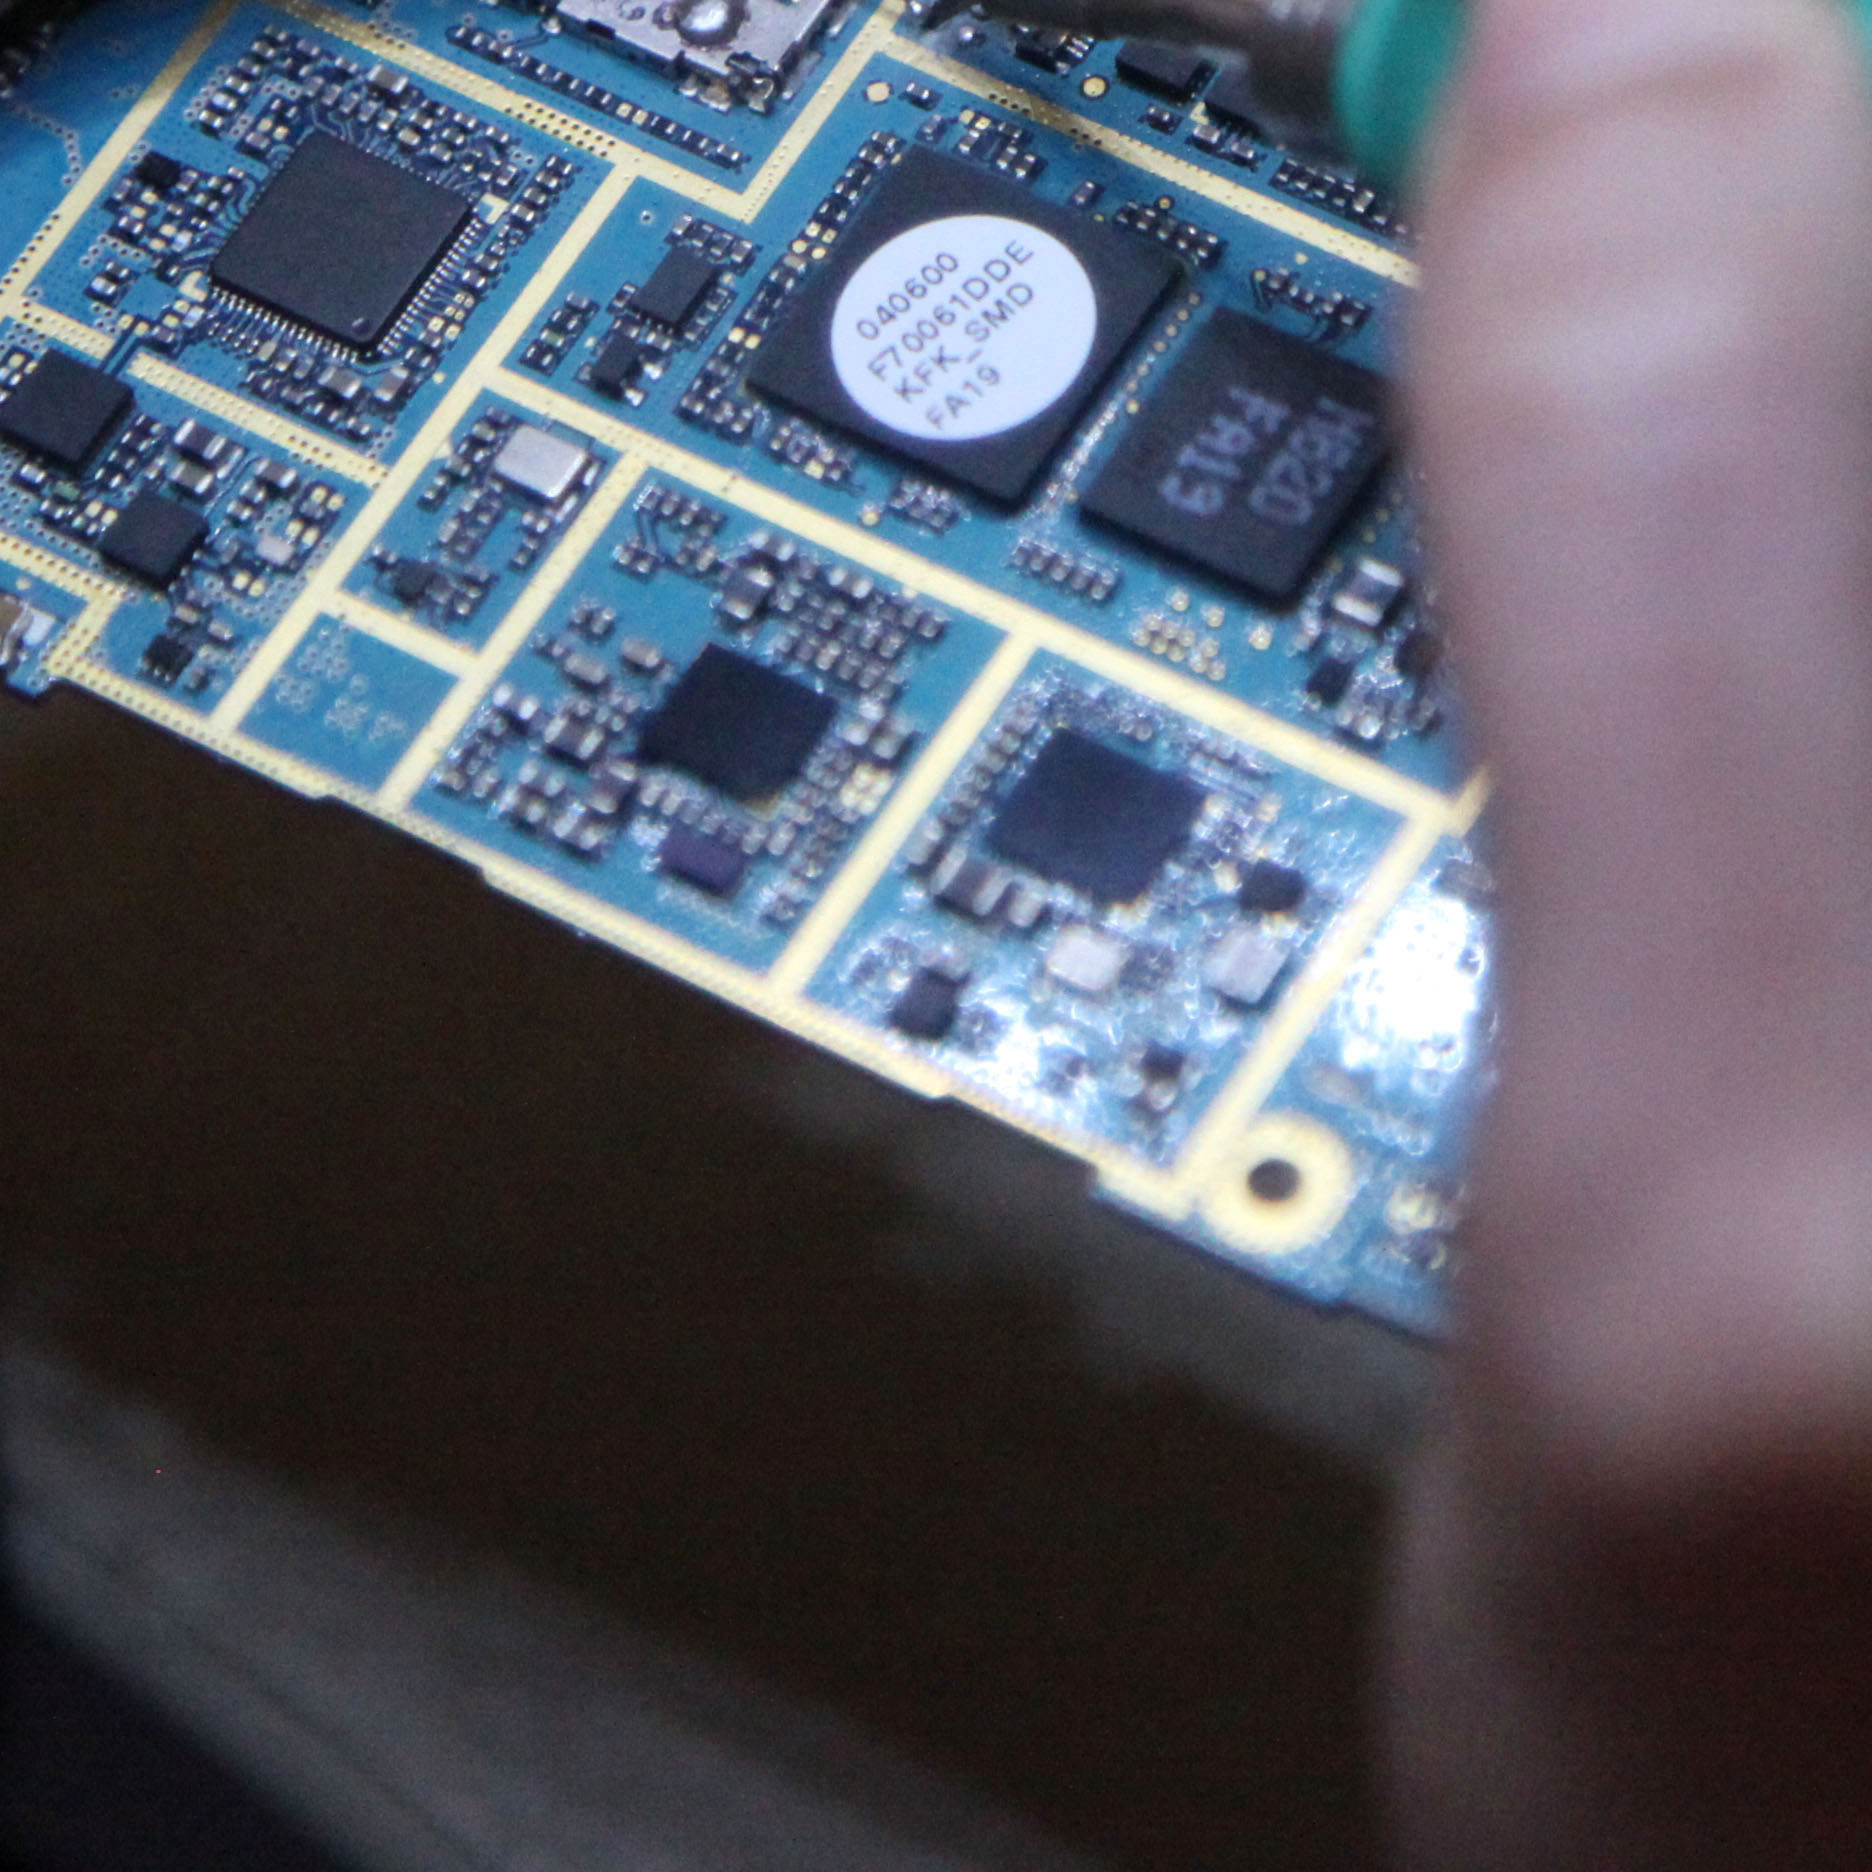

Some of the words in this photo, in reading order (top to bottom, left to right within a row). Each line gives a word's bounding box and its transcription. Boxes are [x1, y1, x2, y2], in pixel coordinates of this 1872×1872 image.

[856, 251, 959, 341] 040600
[867, 240, 1035, 383] F70061DDE
[893, 282, 1034, 403] KFK_SMD
[924, 363, 1001, 430] FA19
